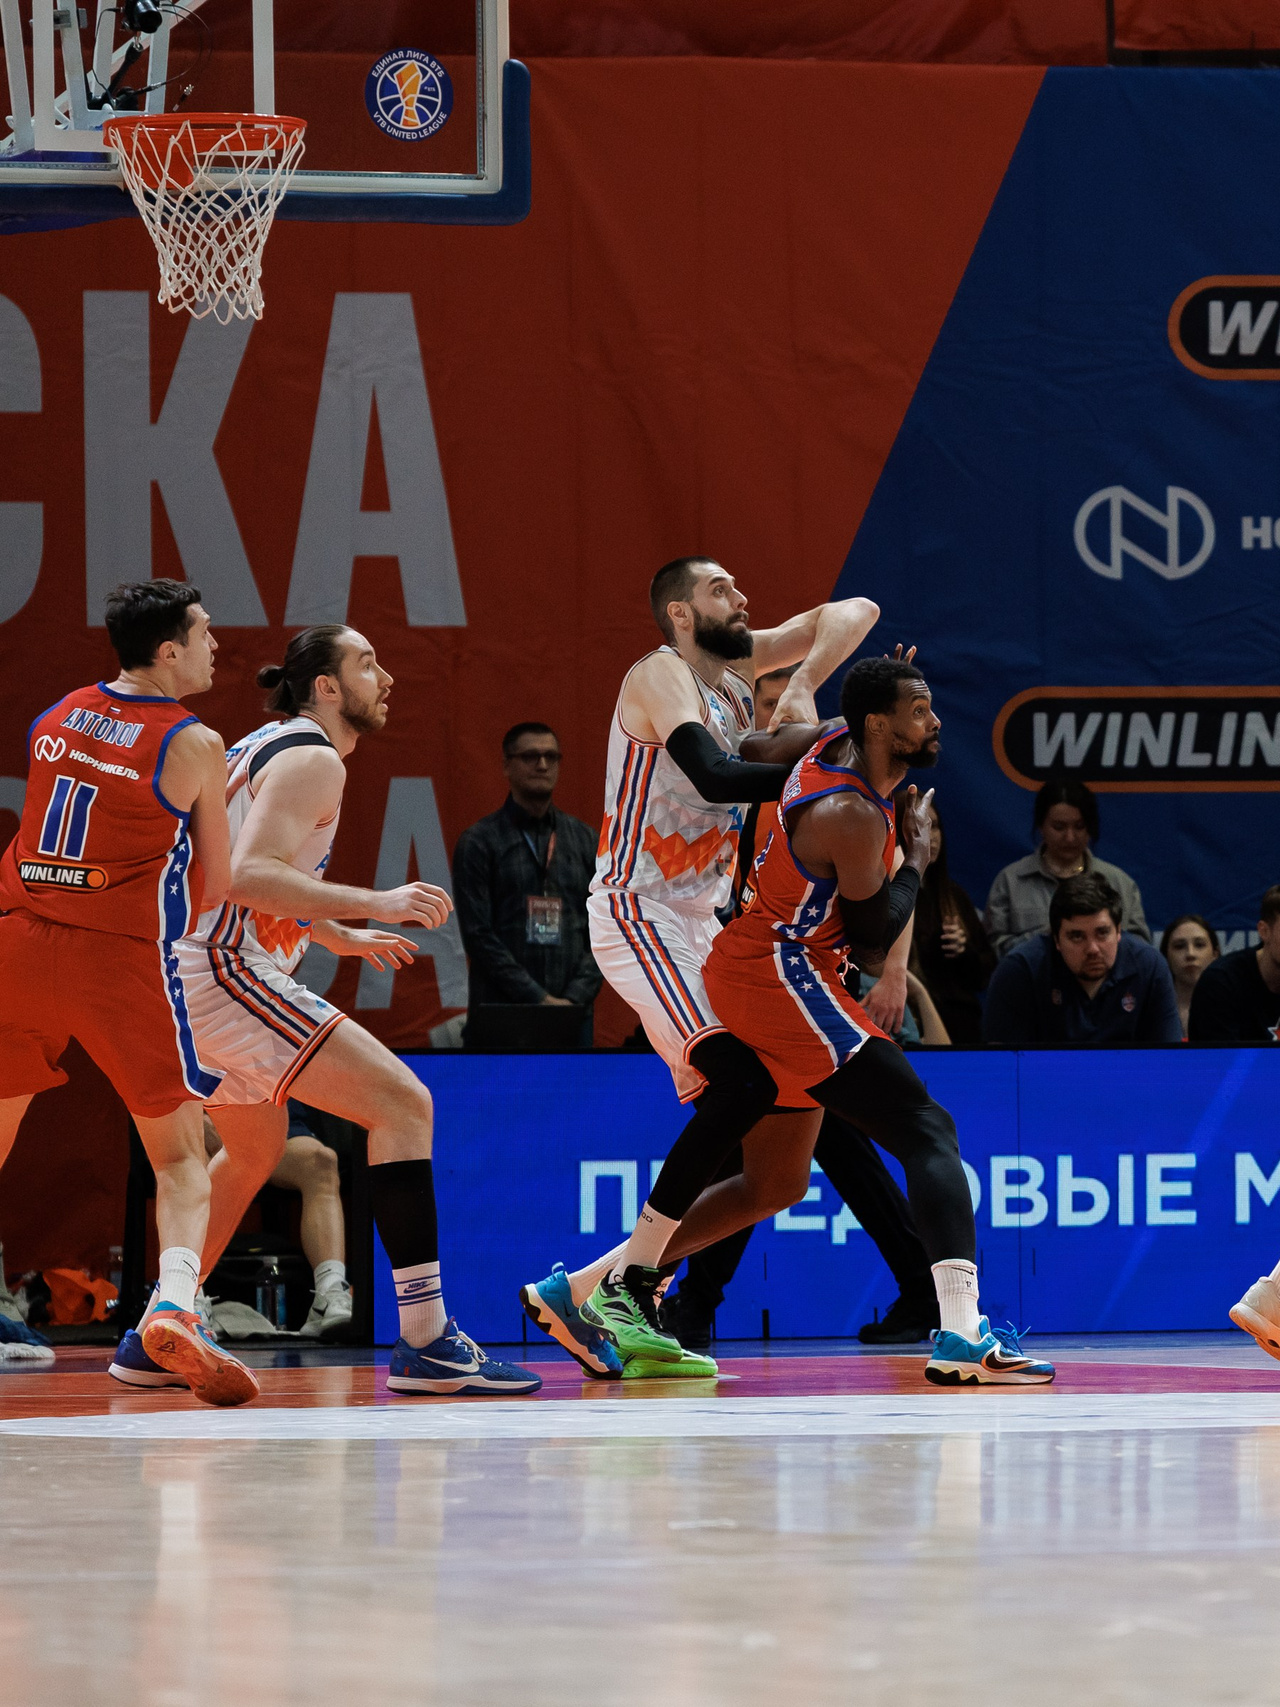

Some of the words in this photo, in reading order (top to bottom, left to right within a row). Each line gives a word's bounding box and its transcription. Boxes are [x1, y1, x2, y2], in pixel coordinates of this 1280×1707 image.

[371, 50, 404, 78] ЕДИНАЯ
[406, 50, 429, 64] ЛИГА
[430, 61, 445, 77] ВТБ
[373, 111, 387, 128] VTB
[386, 125, 418, 140] UNITED
[418, 111, 447, 138] LEAGUE
[60, 707, 145, 748] ANTONOV
[68, 749, 140, 781] НОРНИКЕЛЬ
[37, 774, 99, 862] 11
[20, 864, 85, 885] WINLINE
[408, 1280, 428, 1289] NIKE
